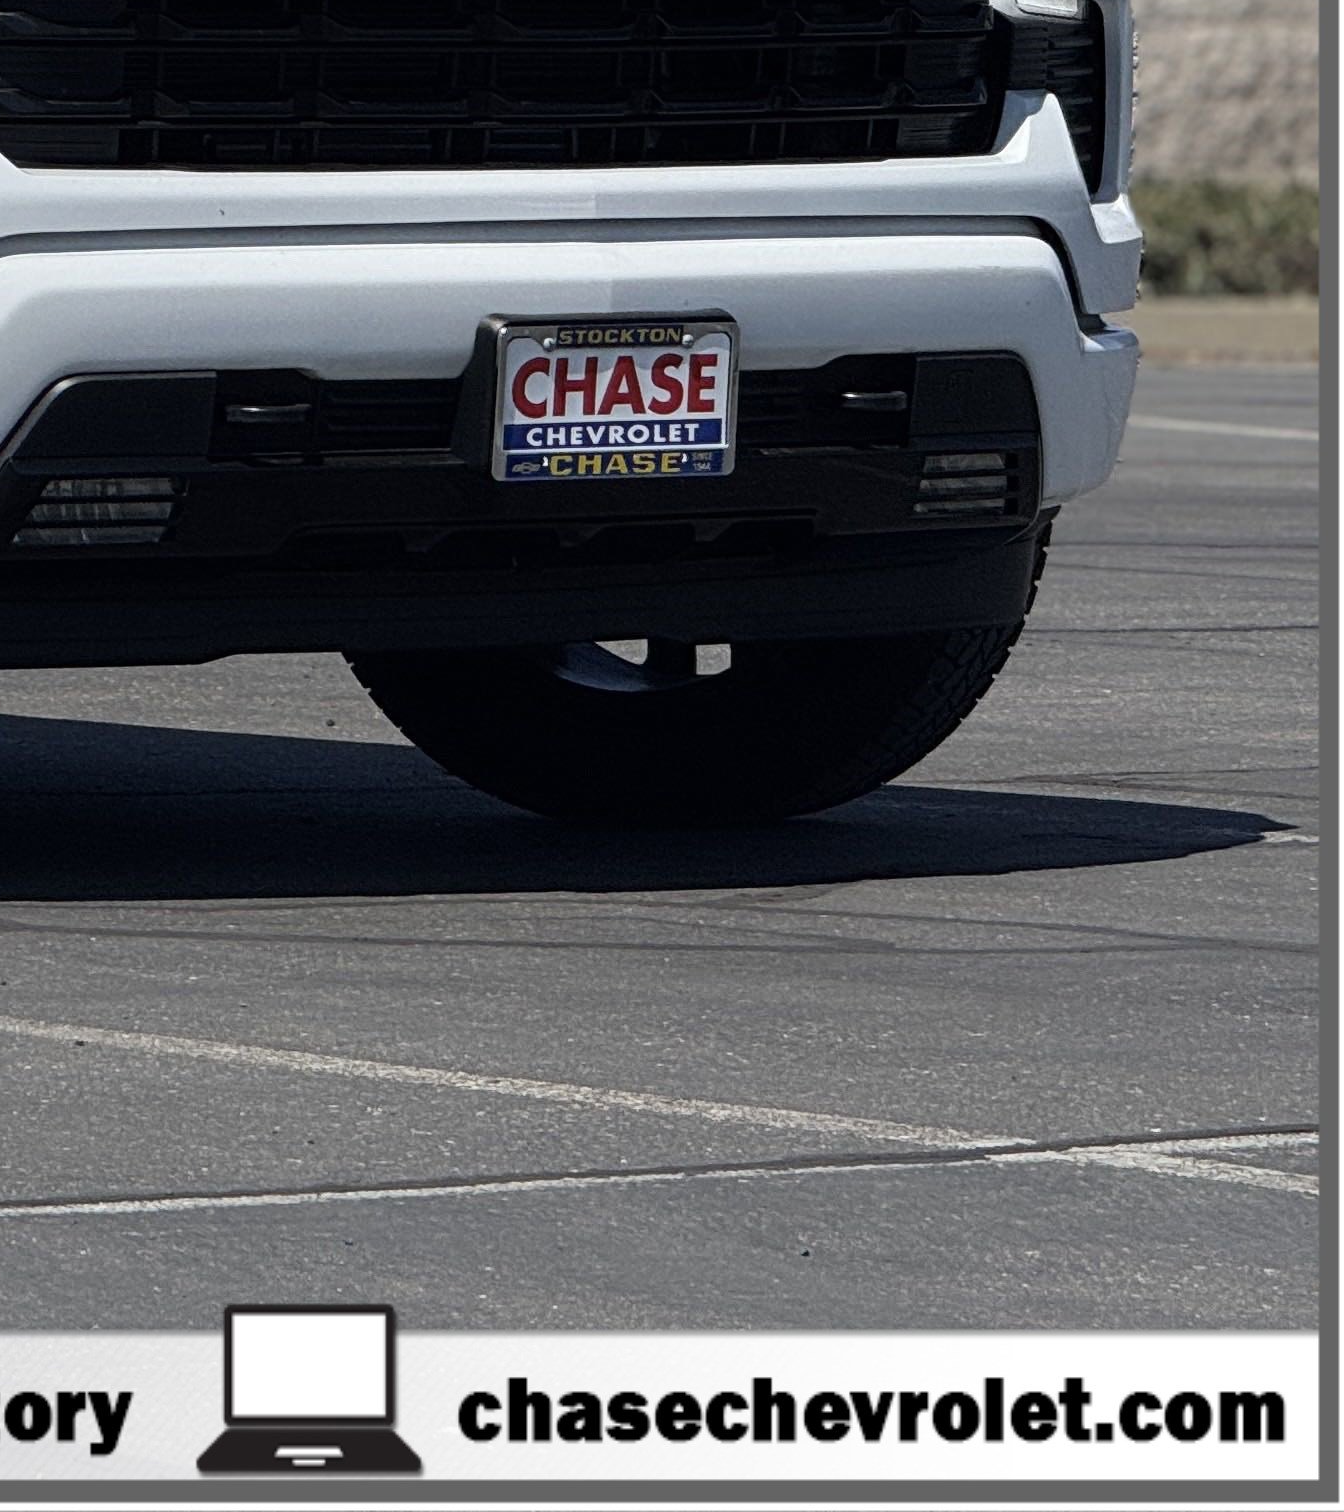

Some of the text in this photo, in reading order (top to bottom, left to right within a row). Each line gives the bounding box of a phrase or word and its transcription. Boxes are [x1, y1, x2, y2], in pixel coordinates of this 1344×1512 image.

[558, 327, 683, 345] STOCKTON
[511, 353, 718, 419] CHASE
[526, 423, 700, 447] CHEVROLET
[549, 452, 683, 476] CHASE
